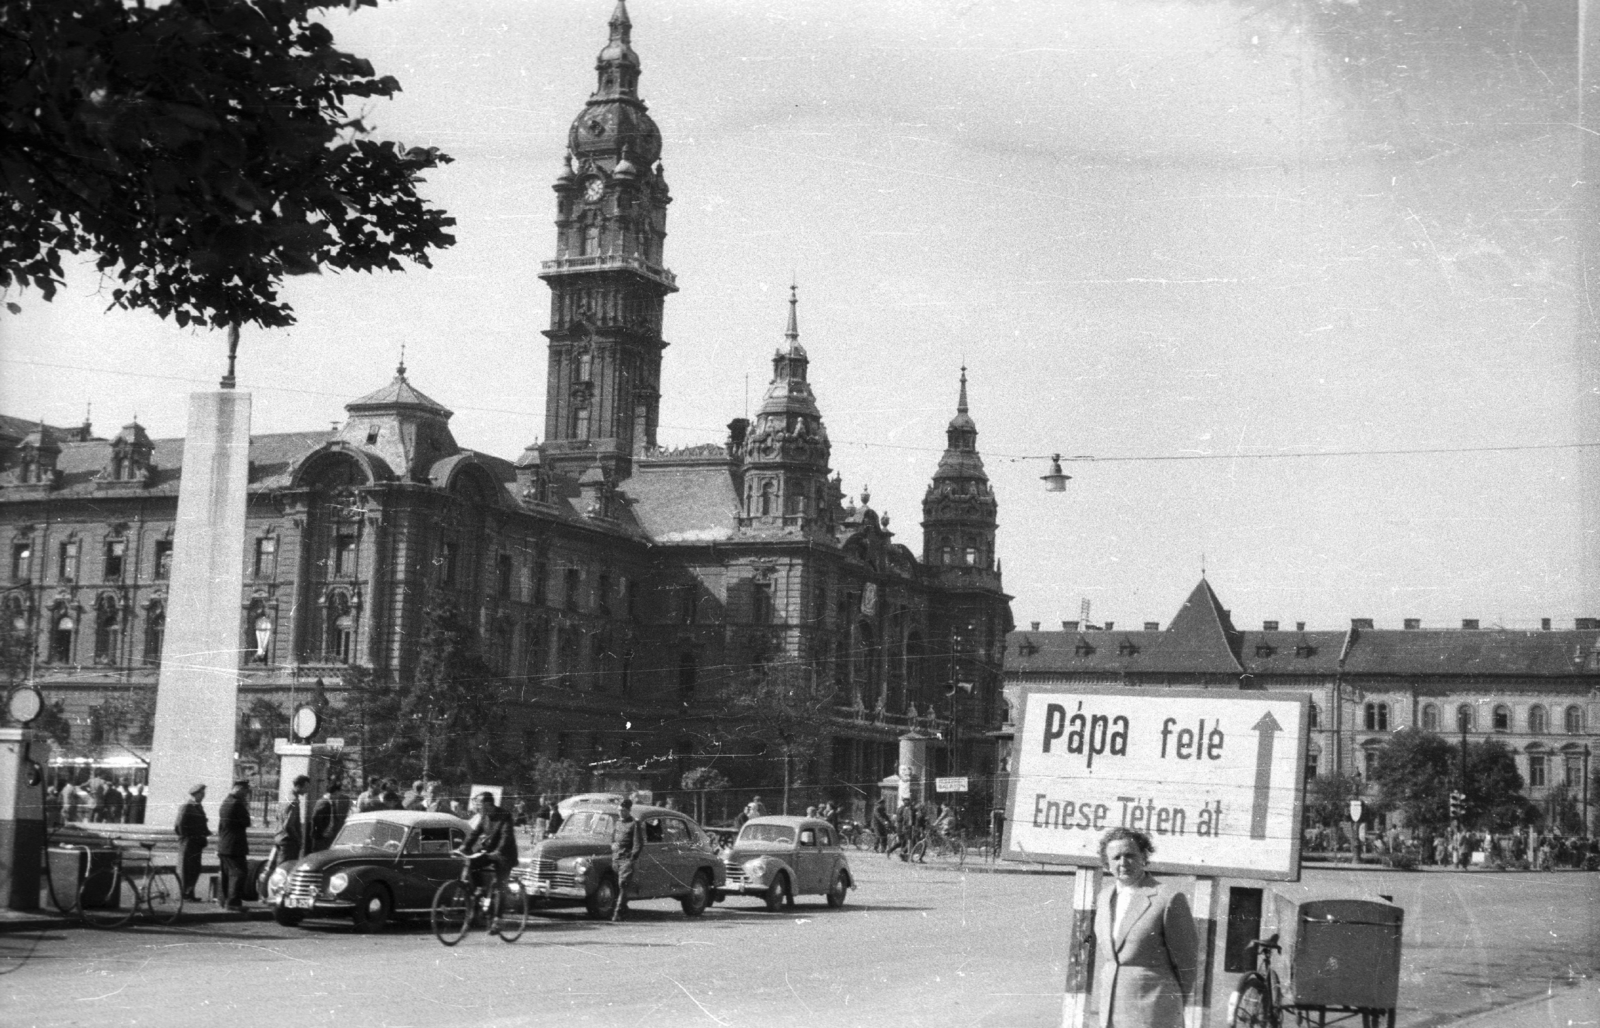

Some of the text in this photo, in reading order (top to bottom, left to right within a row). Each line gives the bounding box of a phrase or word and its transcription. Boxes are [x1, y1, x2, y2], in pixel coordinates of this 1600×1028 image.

[1042, 700, 1224, 768] Pápa felé
[1033, 793, 1222, 837] Enese Téten át
